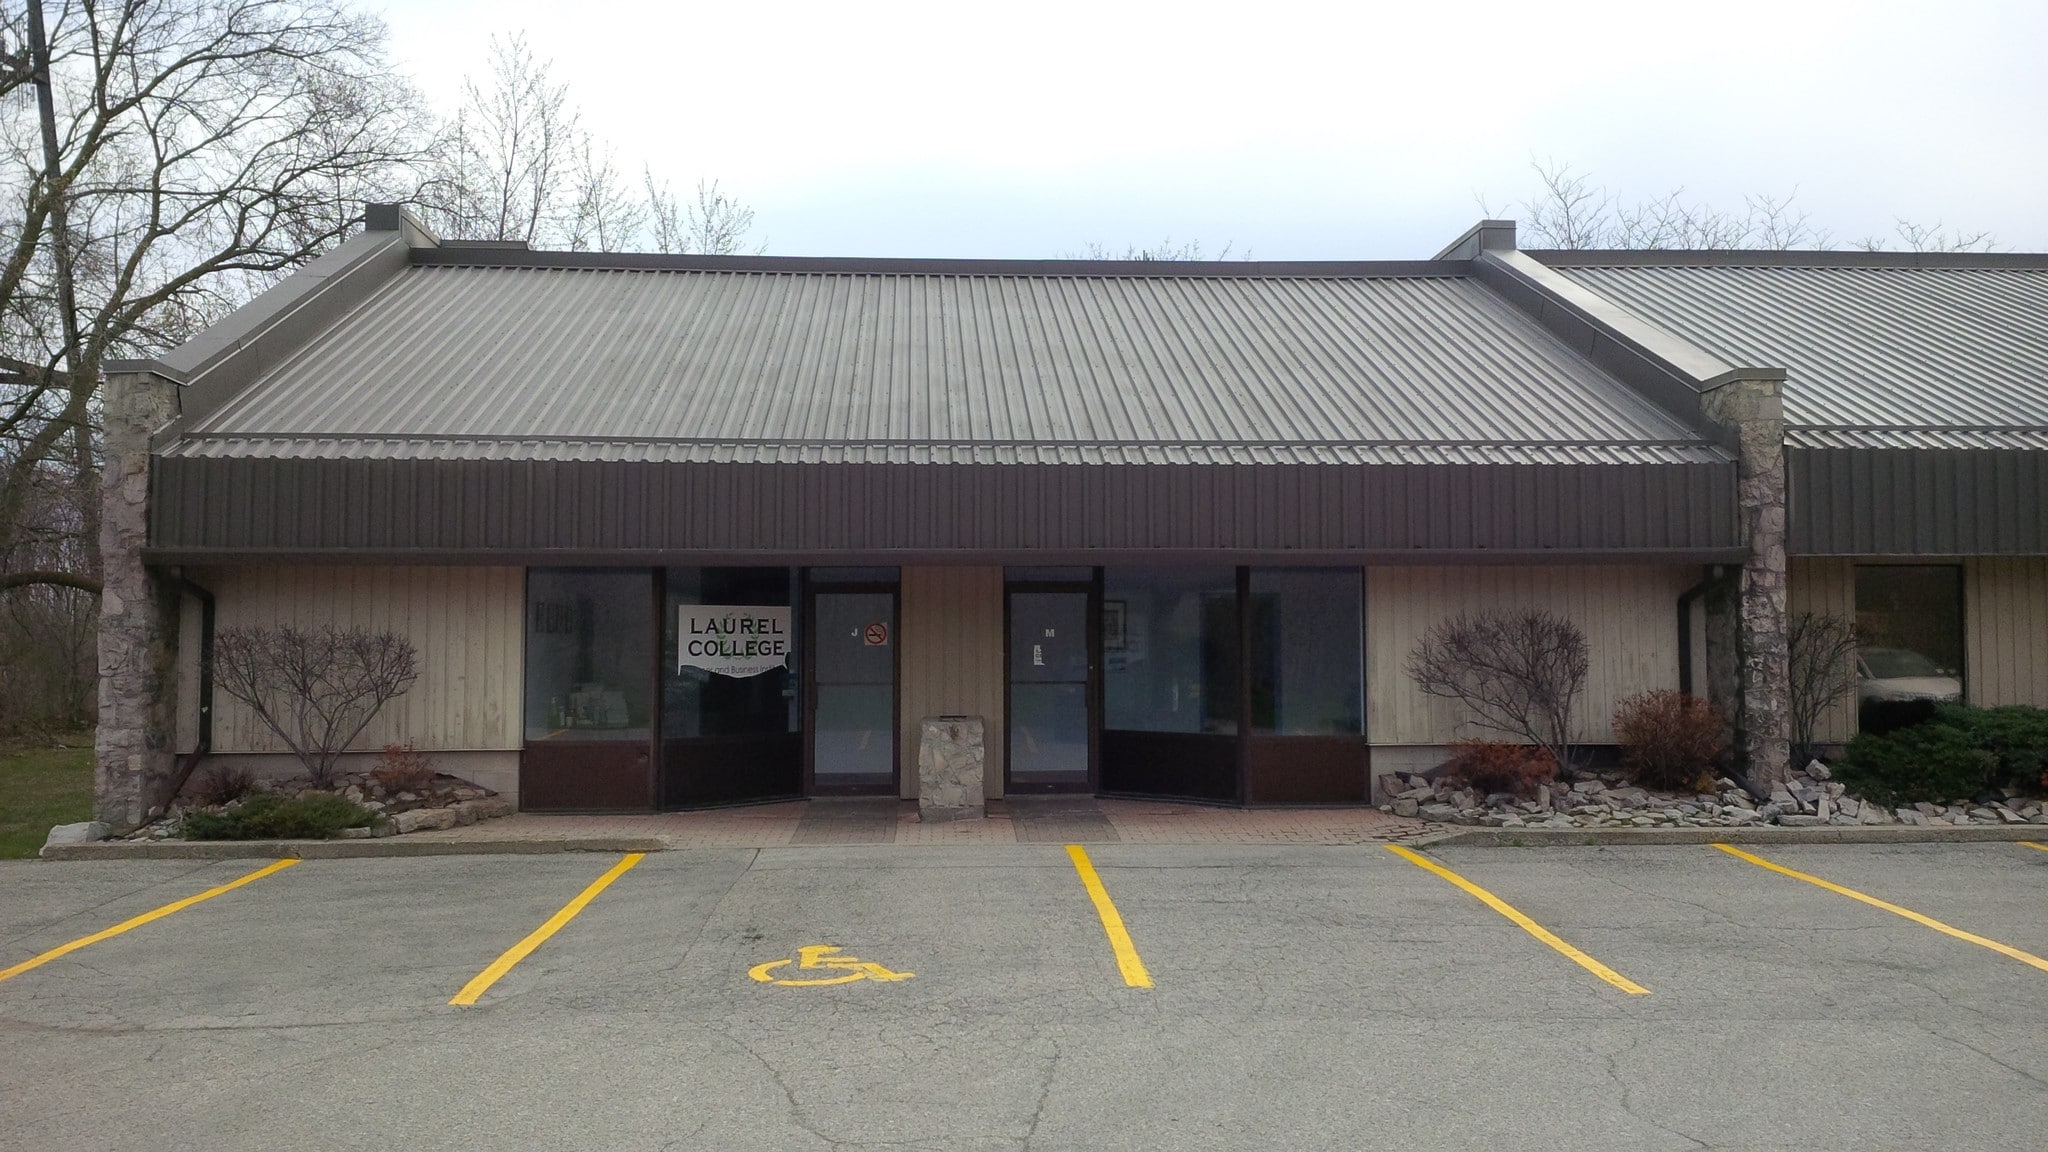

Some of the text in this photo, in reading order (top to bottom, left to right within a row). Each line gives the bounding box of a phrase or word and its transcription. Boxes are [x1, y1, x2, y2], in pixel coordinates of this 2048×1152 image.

[690, 618, 784, 635] LAUREL
[851, 628, 858, 637] J
[1045, 628, 1055, 638] M
[688, 640, 785, 657] COLLEGE
[714, 665, 730, 674] and
[731, 665, 759, 674] Business
